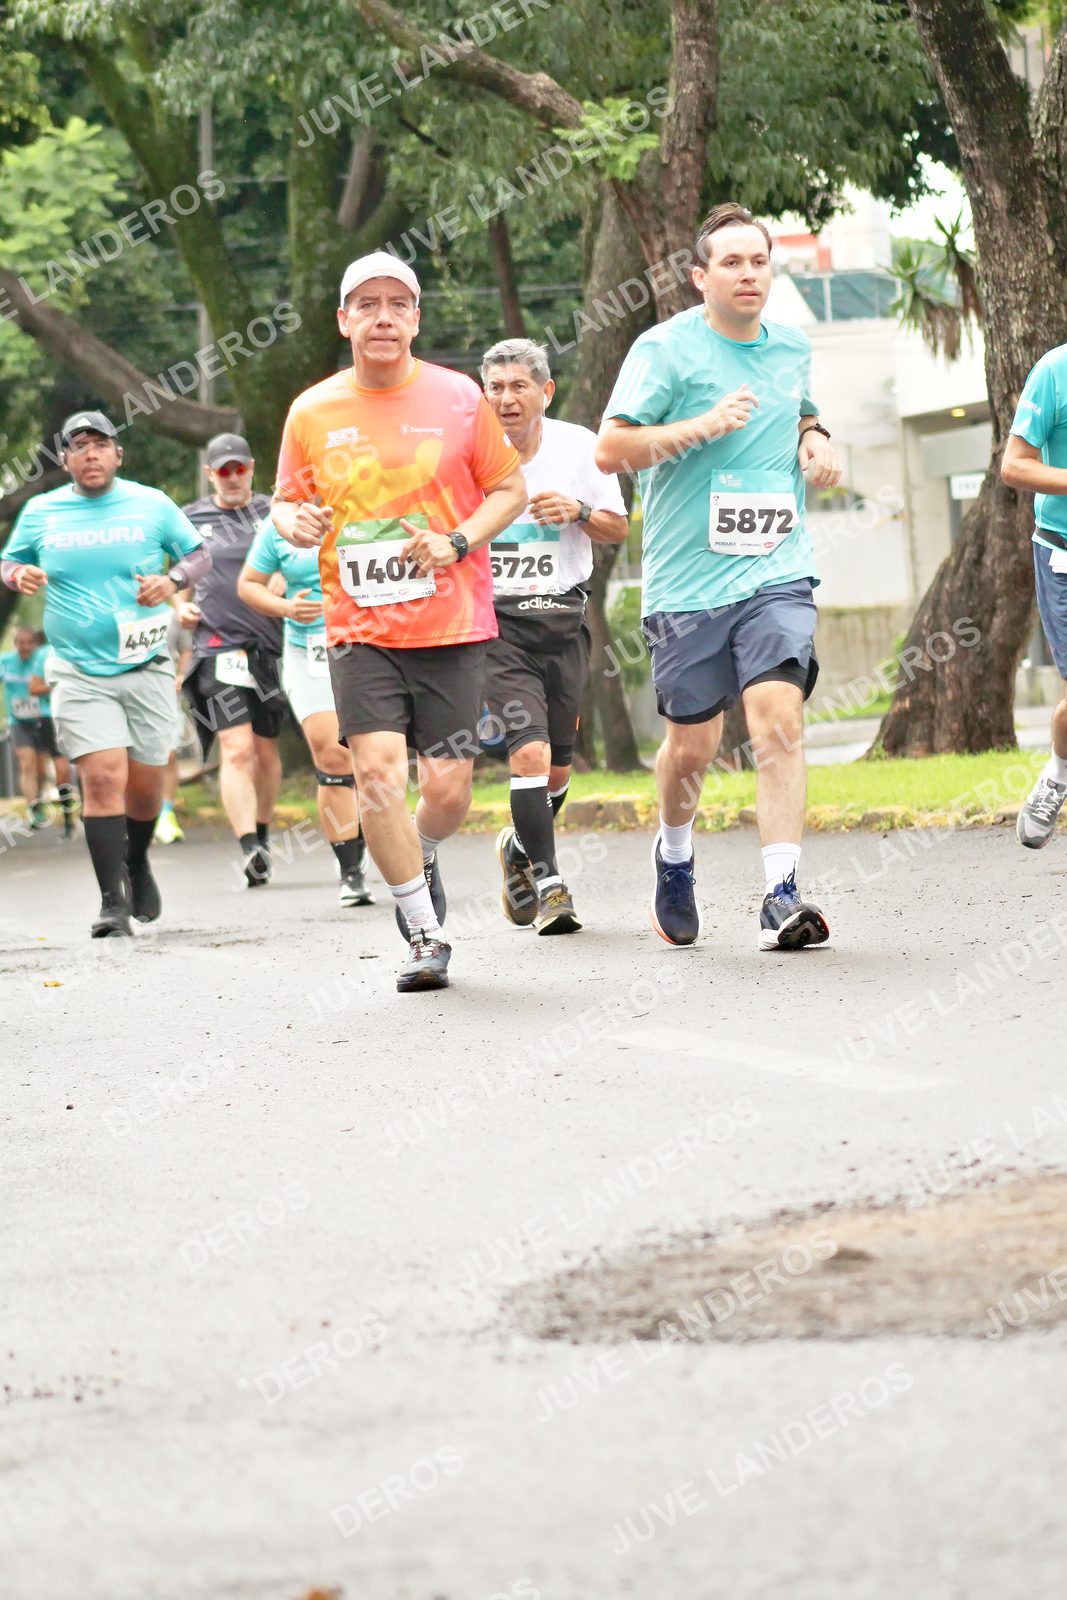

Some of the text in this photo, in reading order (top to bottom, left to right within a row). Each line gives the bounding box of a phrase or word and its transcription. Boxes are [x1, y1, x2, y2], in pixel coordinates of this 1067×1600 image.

[716, 508, 793, 534] 5872
[45, 527, 146, 549] PERDURA
[490, 554, 553, 579] 6726
[125, 625, 168, 650] 4422
